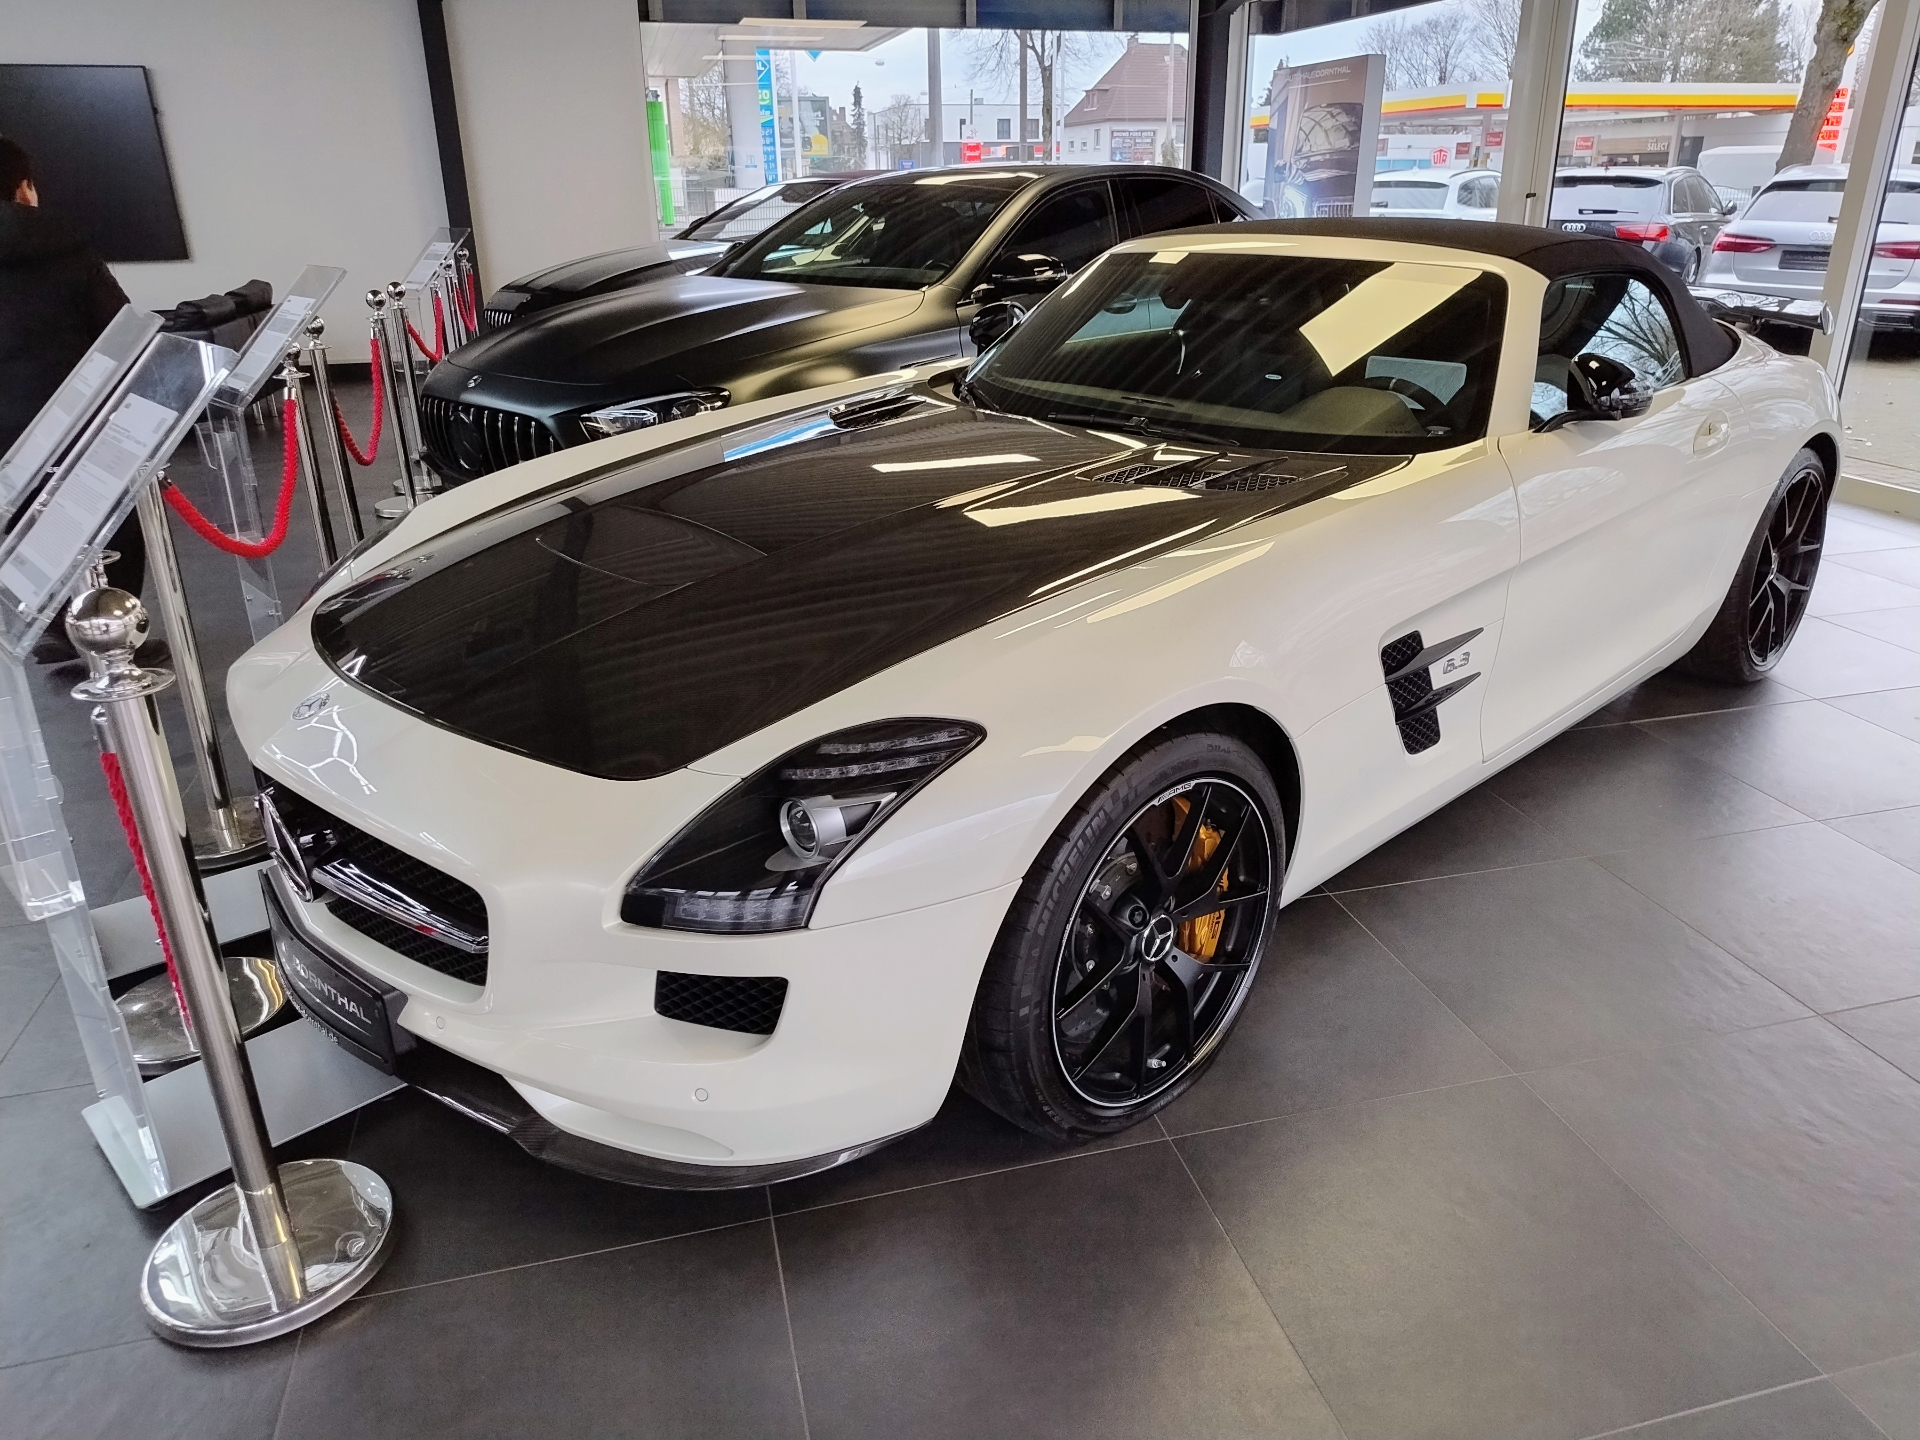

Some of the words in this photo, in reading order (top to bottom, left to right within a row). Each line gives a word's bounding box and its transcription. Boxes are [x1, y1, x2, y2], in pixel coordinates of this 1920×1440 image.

[1647, 142, 1669, 151] SELECT
[1442, 651, 1470, 675] 6.3
[1036, 808, 1107, 937] MICHELIN
